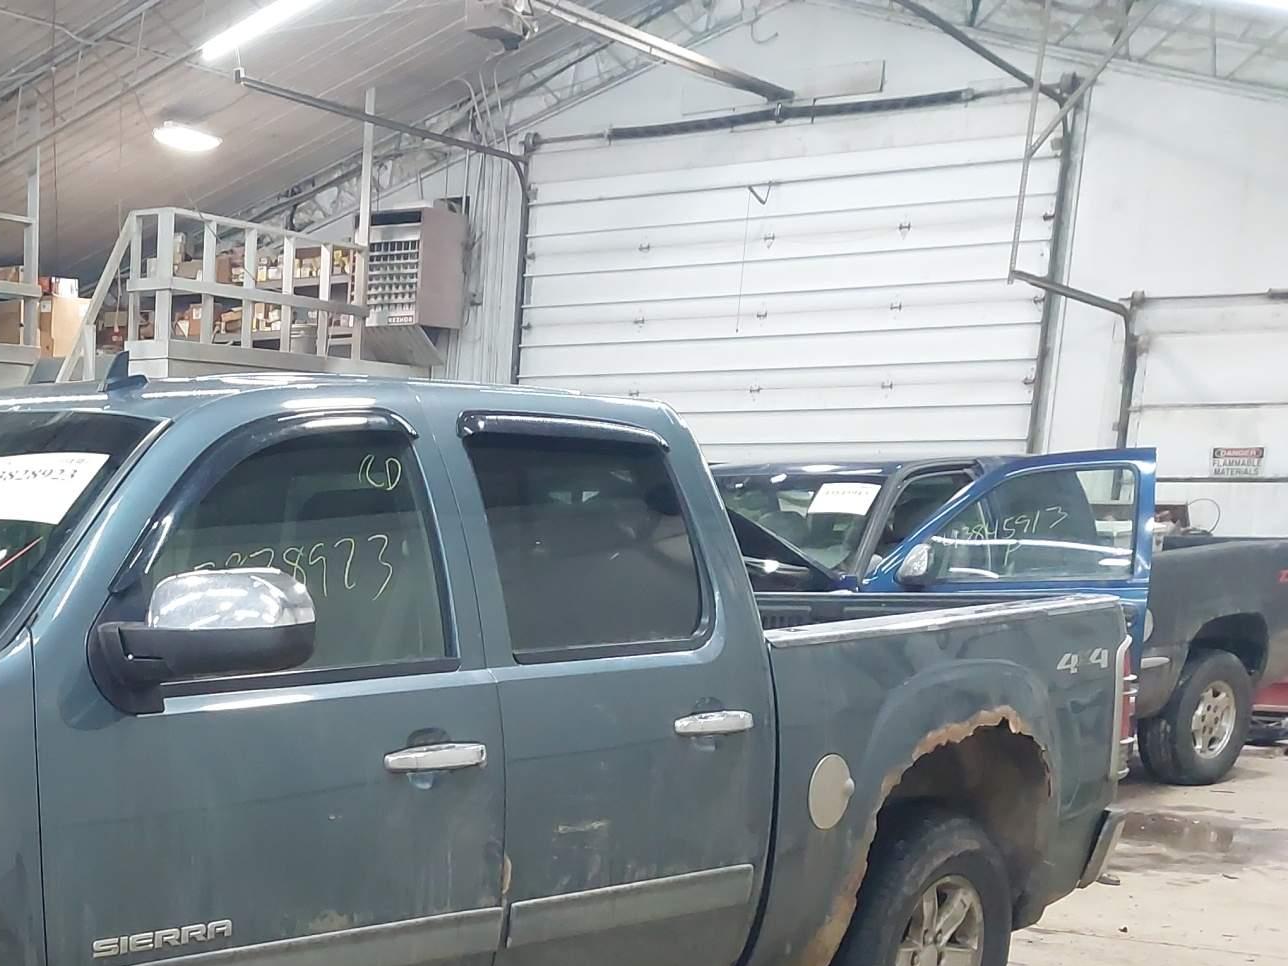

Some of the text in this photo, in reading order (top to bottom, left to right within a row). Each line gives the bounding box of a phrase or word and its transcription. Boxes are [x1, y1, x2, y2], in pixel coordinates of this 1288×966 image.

[1213, 458, 1262, 467] FLAMMABLE
[1214, 467, 1259, 476] MATERIALS
[92, 919, 233, 958] SIERRA
